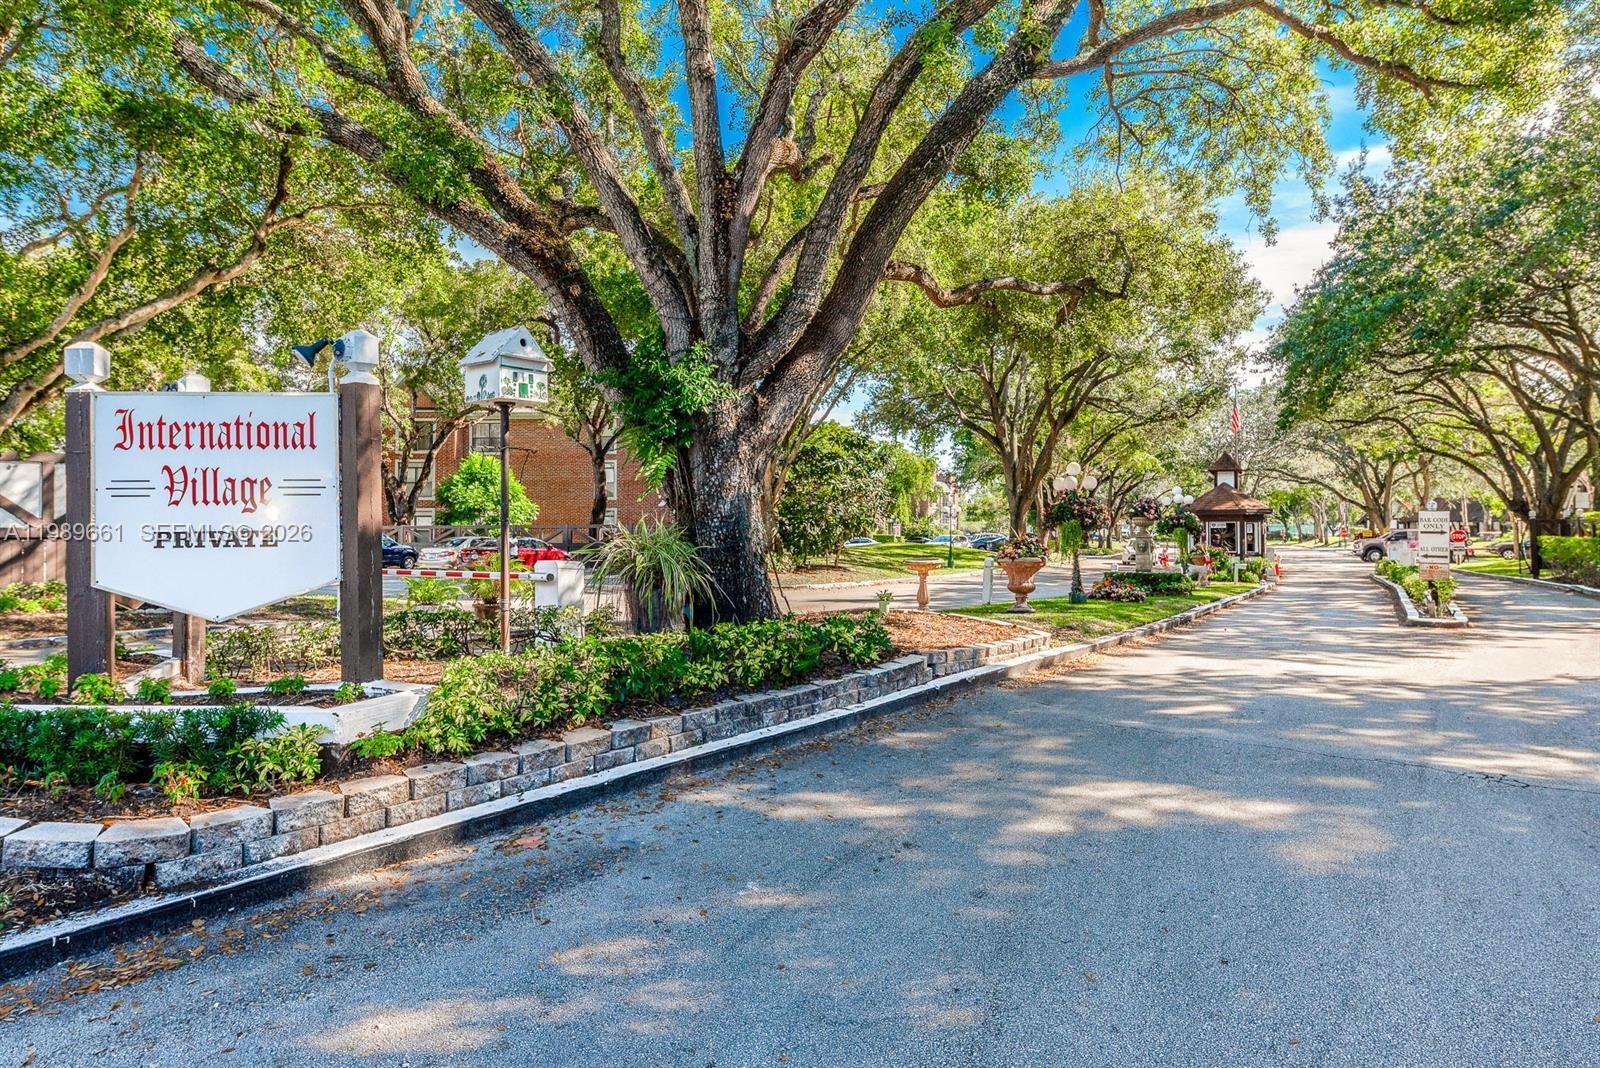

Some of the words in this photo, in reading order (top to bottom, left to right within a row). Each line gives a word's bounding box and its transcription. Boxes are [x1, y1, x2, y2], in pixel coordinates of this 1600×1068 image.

[113, 408, 317, 451] International
[162, 465, 273, 513] Village
[153, 530, 279, 549] PRIVATE
